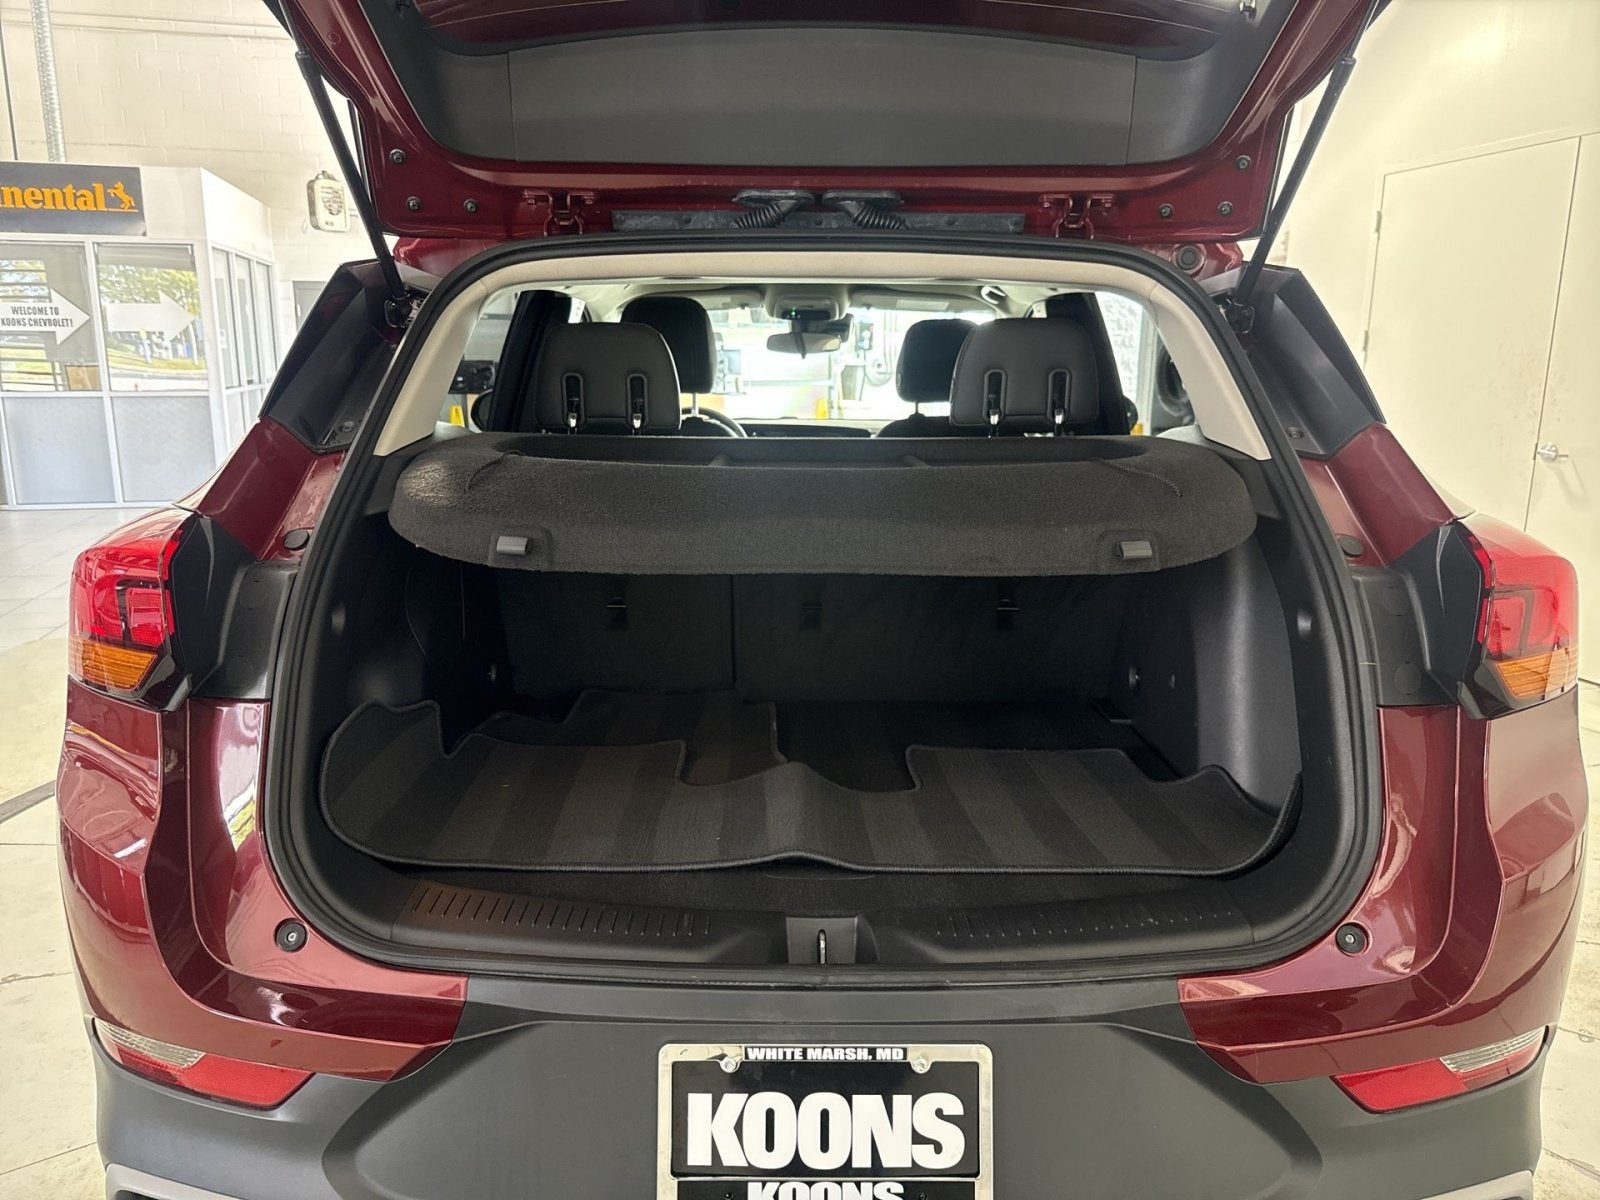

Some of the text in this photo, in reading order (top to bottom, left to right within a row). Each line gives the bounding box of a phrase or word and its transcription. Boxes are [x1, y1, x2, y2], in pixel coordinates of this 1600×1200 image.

[0, 183, 106, 211] nental
[11, 306, 60, 316] WELCOME TO
[1, 317, 73, 328] KOONS CHEVROLET!
[747, 1047, 803, 1060] WHITE
[876, 1047, 904, 1060] MD
[686, 1091, 966, 1170] KOONS
